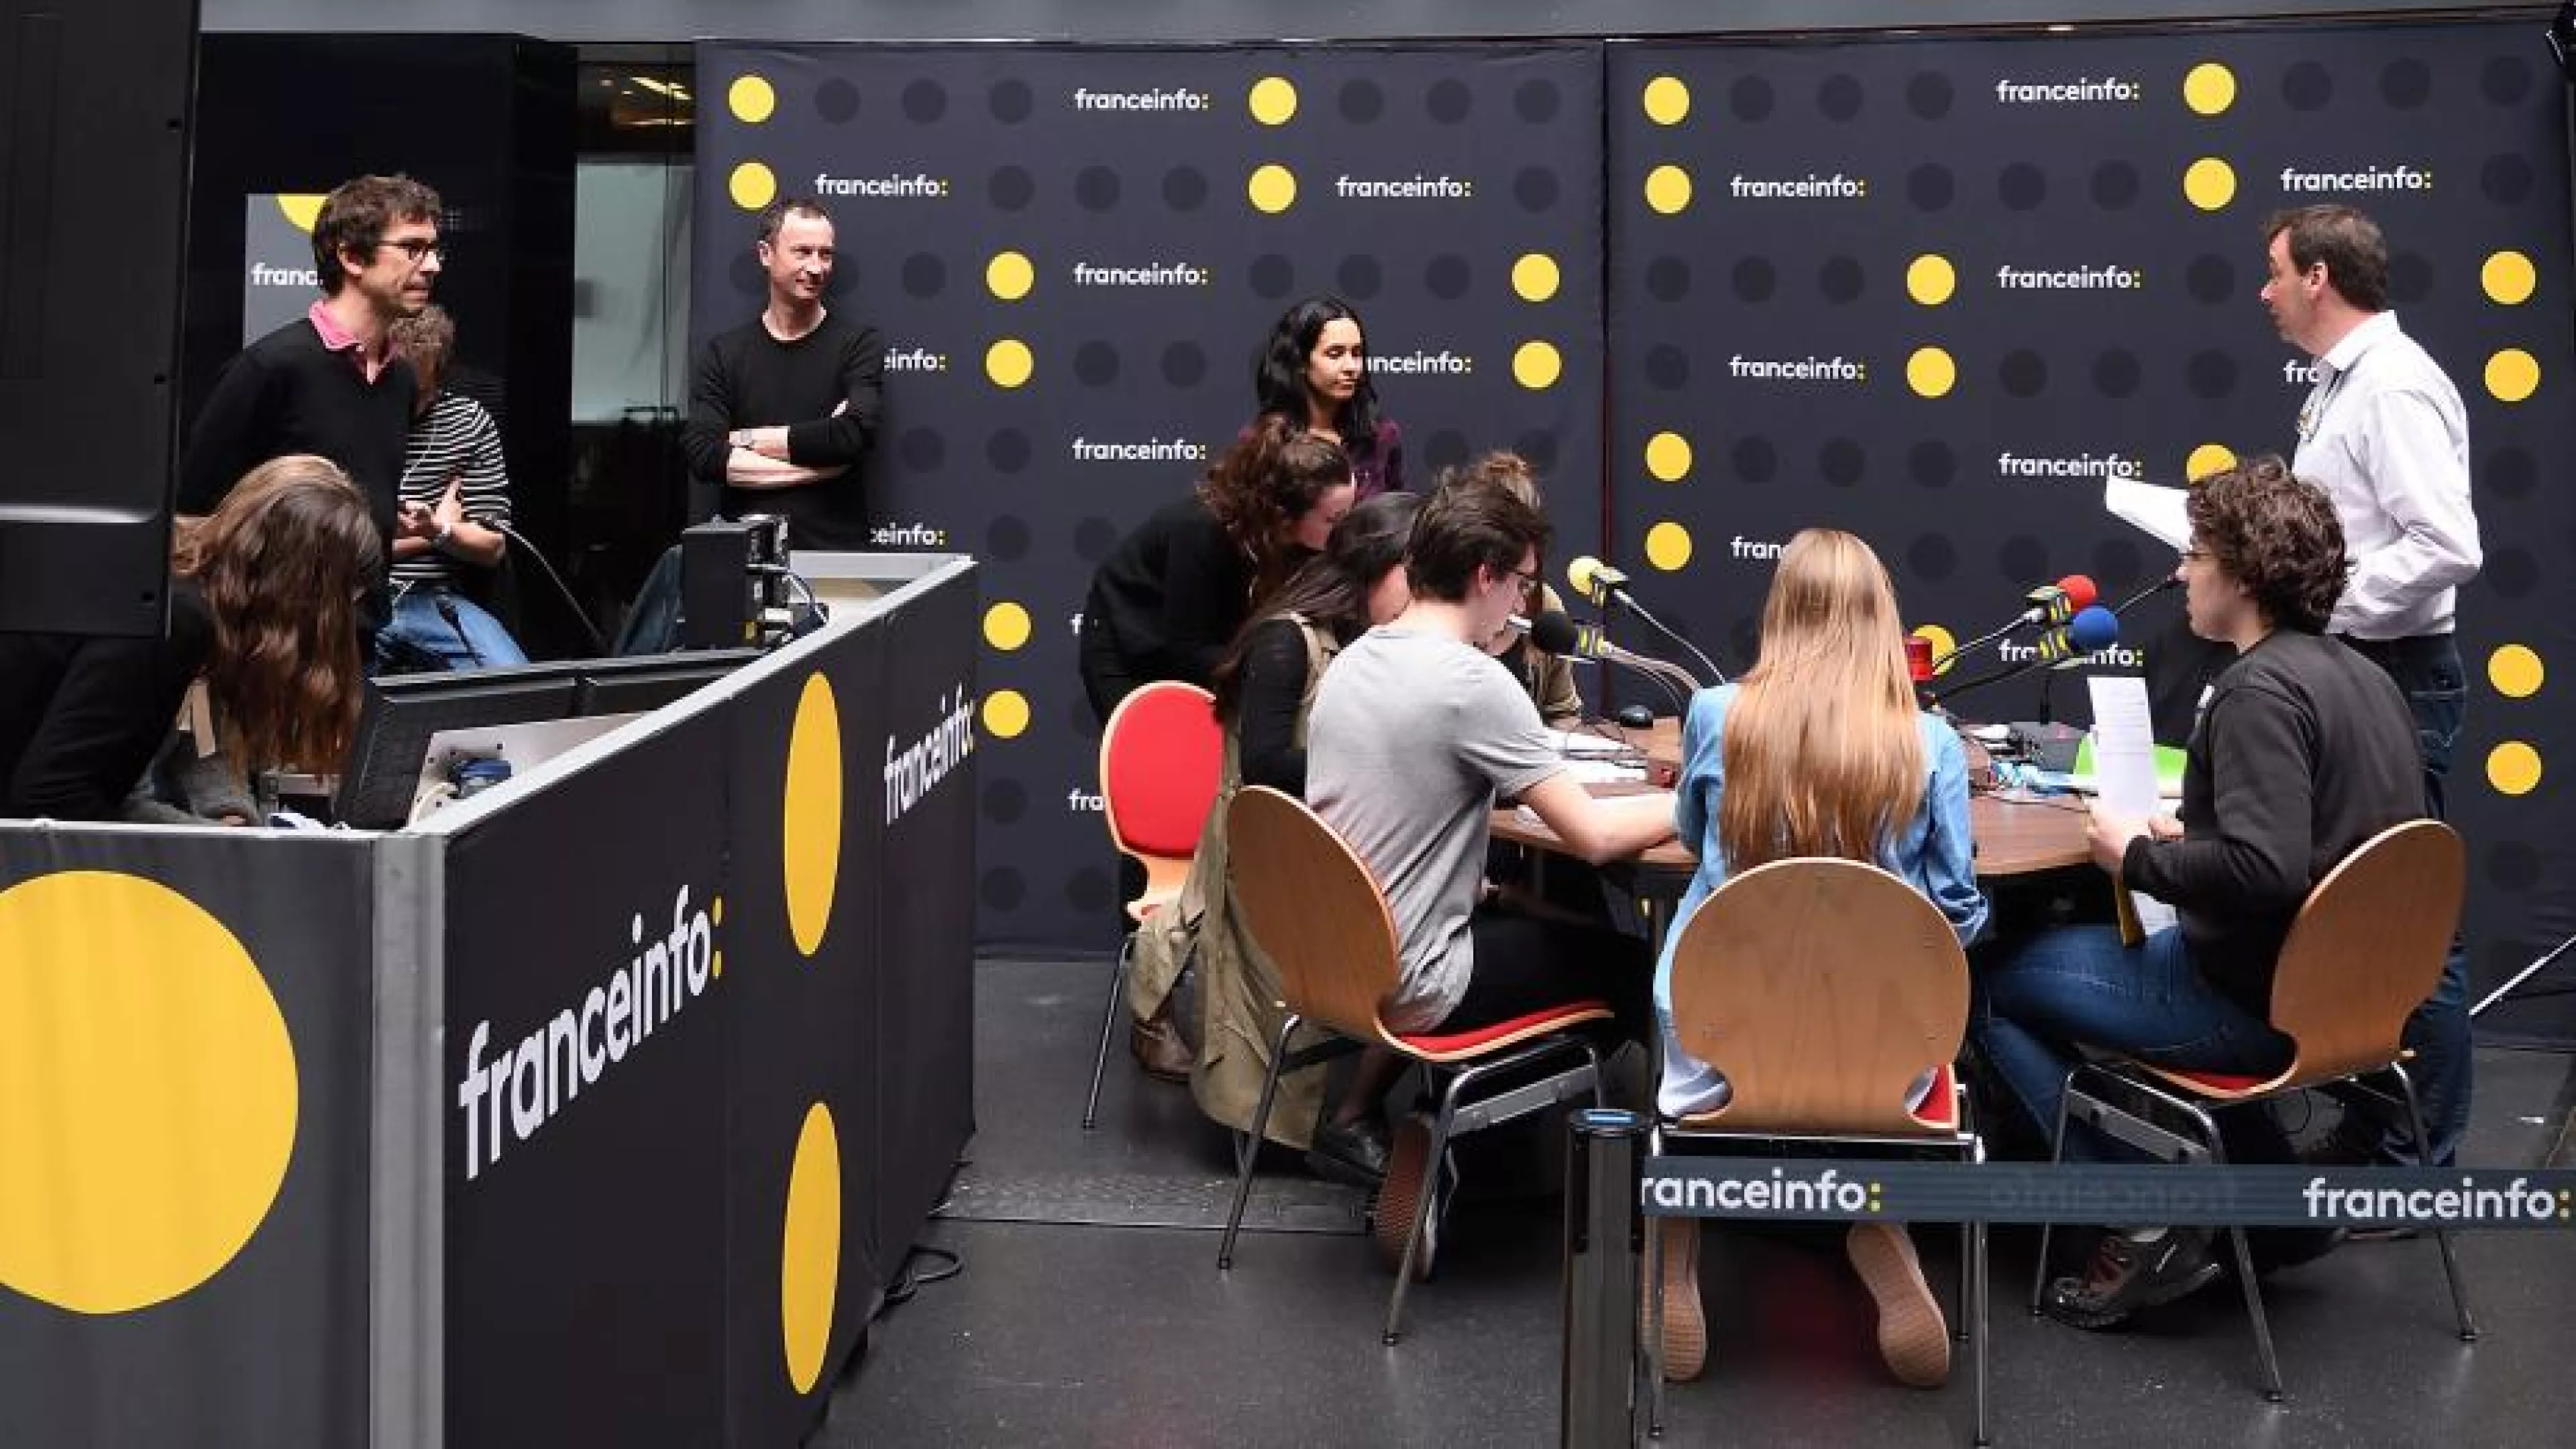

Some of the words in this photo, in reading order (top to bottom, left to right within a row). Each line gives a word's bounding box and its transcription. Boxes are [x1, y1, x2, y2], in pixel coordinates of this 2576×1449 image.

[1074, 88, 1209, 111] franceinfo:
[1996, 77, 2140, 102] franceinfo:
[814, 174, 949, 197] franceinfo:
[1334, 174, 1472, 197] franceinfo:
[1730, 173, 1866, 197] franceinfo:
[2280, 166, 2432, 191] franceinfo:
[1074, 262, 1209, 285] franceinfo:
[1997, 266, 2141, 288] franceinfo:
[1367, 350, 1472, 373] nceinfo:
[1729, 356, 1866, 380] franceinfo:
[1072, 437, 1206, 460] franceinfo:
[1998, 453, 2143, 477] franceinfo:
[871, 522, 945, 545] einfo:
[883, 680, 975, 826] franceinfo:
[459, 884, 722, 1180] franceinfo:
[1642, 1167, 1880, 1212] ranceinfo:
[2302, 1177, 2571, 1220] franceinfo:
